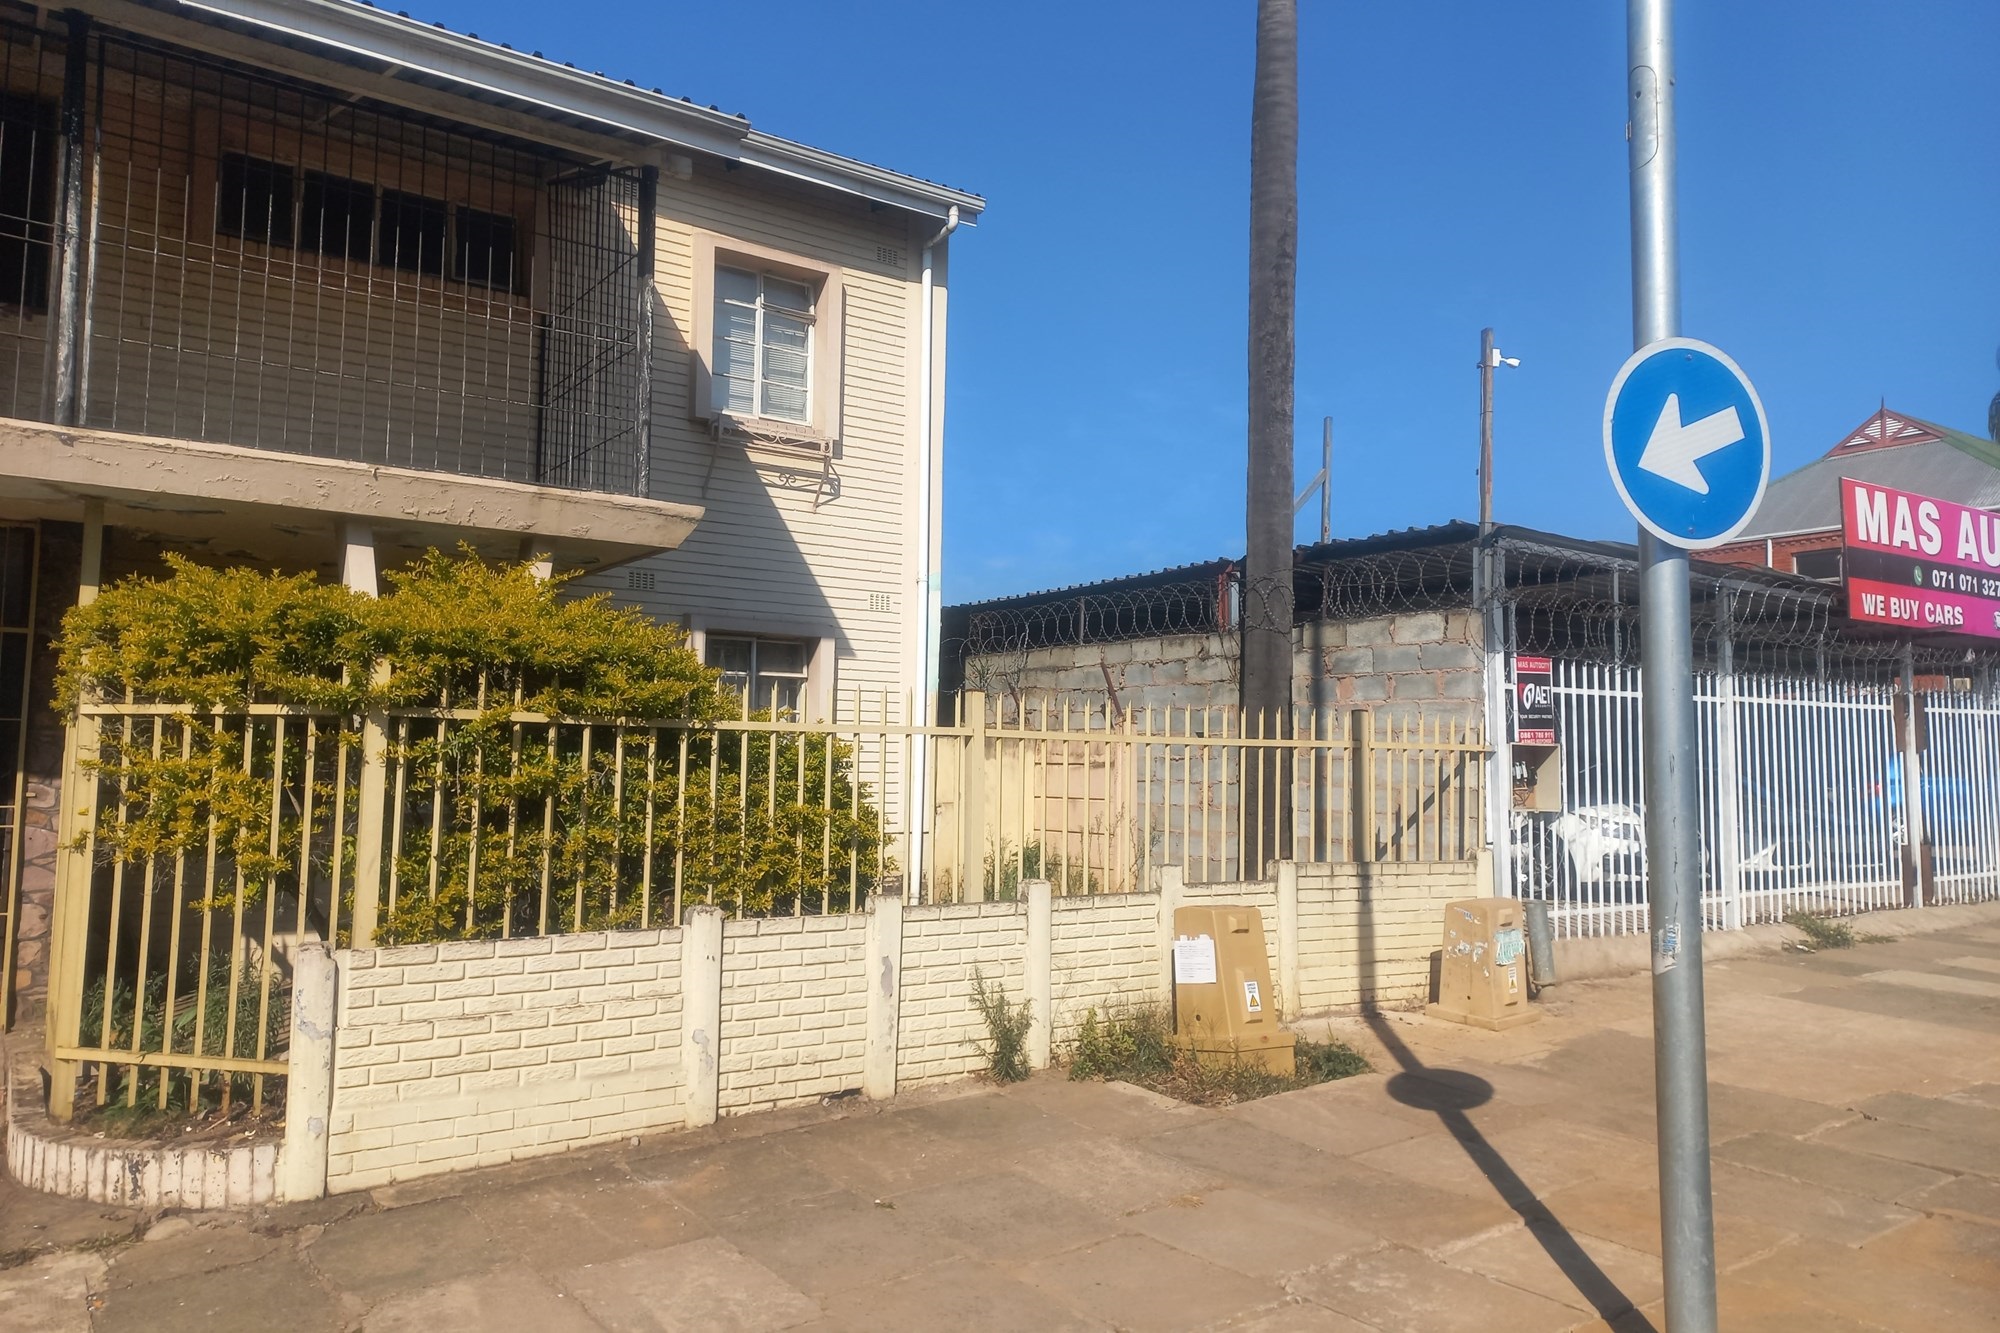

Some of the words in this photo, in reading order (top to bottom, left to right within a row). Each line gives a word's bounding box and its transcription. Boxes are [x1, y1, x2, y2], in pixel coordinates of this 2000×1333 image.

[1854, 486, 1942, 556] MAS
[1932, 569, 1955, 590] 071
[1959, 573, 1978, 594] 071
[1861, 592, 1886, 617] WE
[1890, 596, 1920, 621] BUY
[1924, 601, 1964, 626] CARS
[1518, 661, 1529, 669] MAS
[1535, 686, 1551, 704] AET
